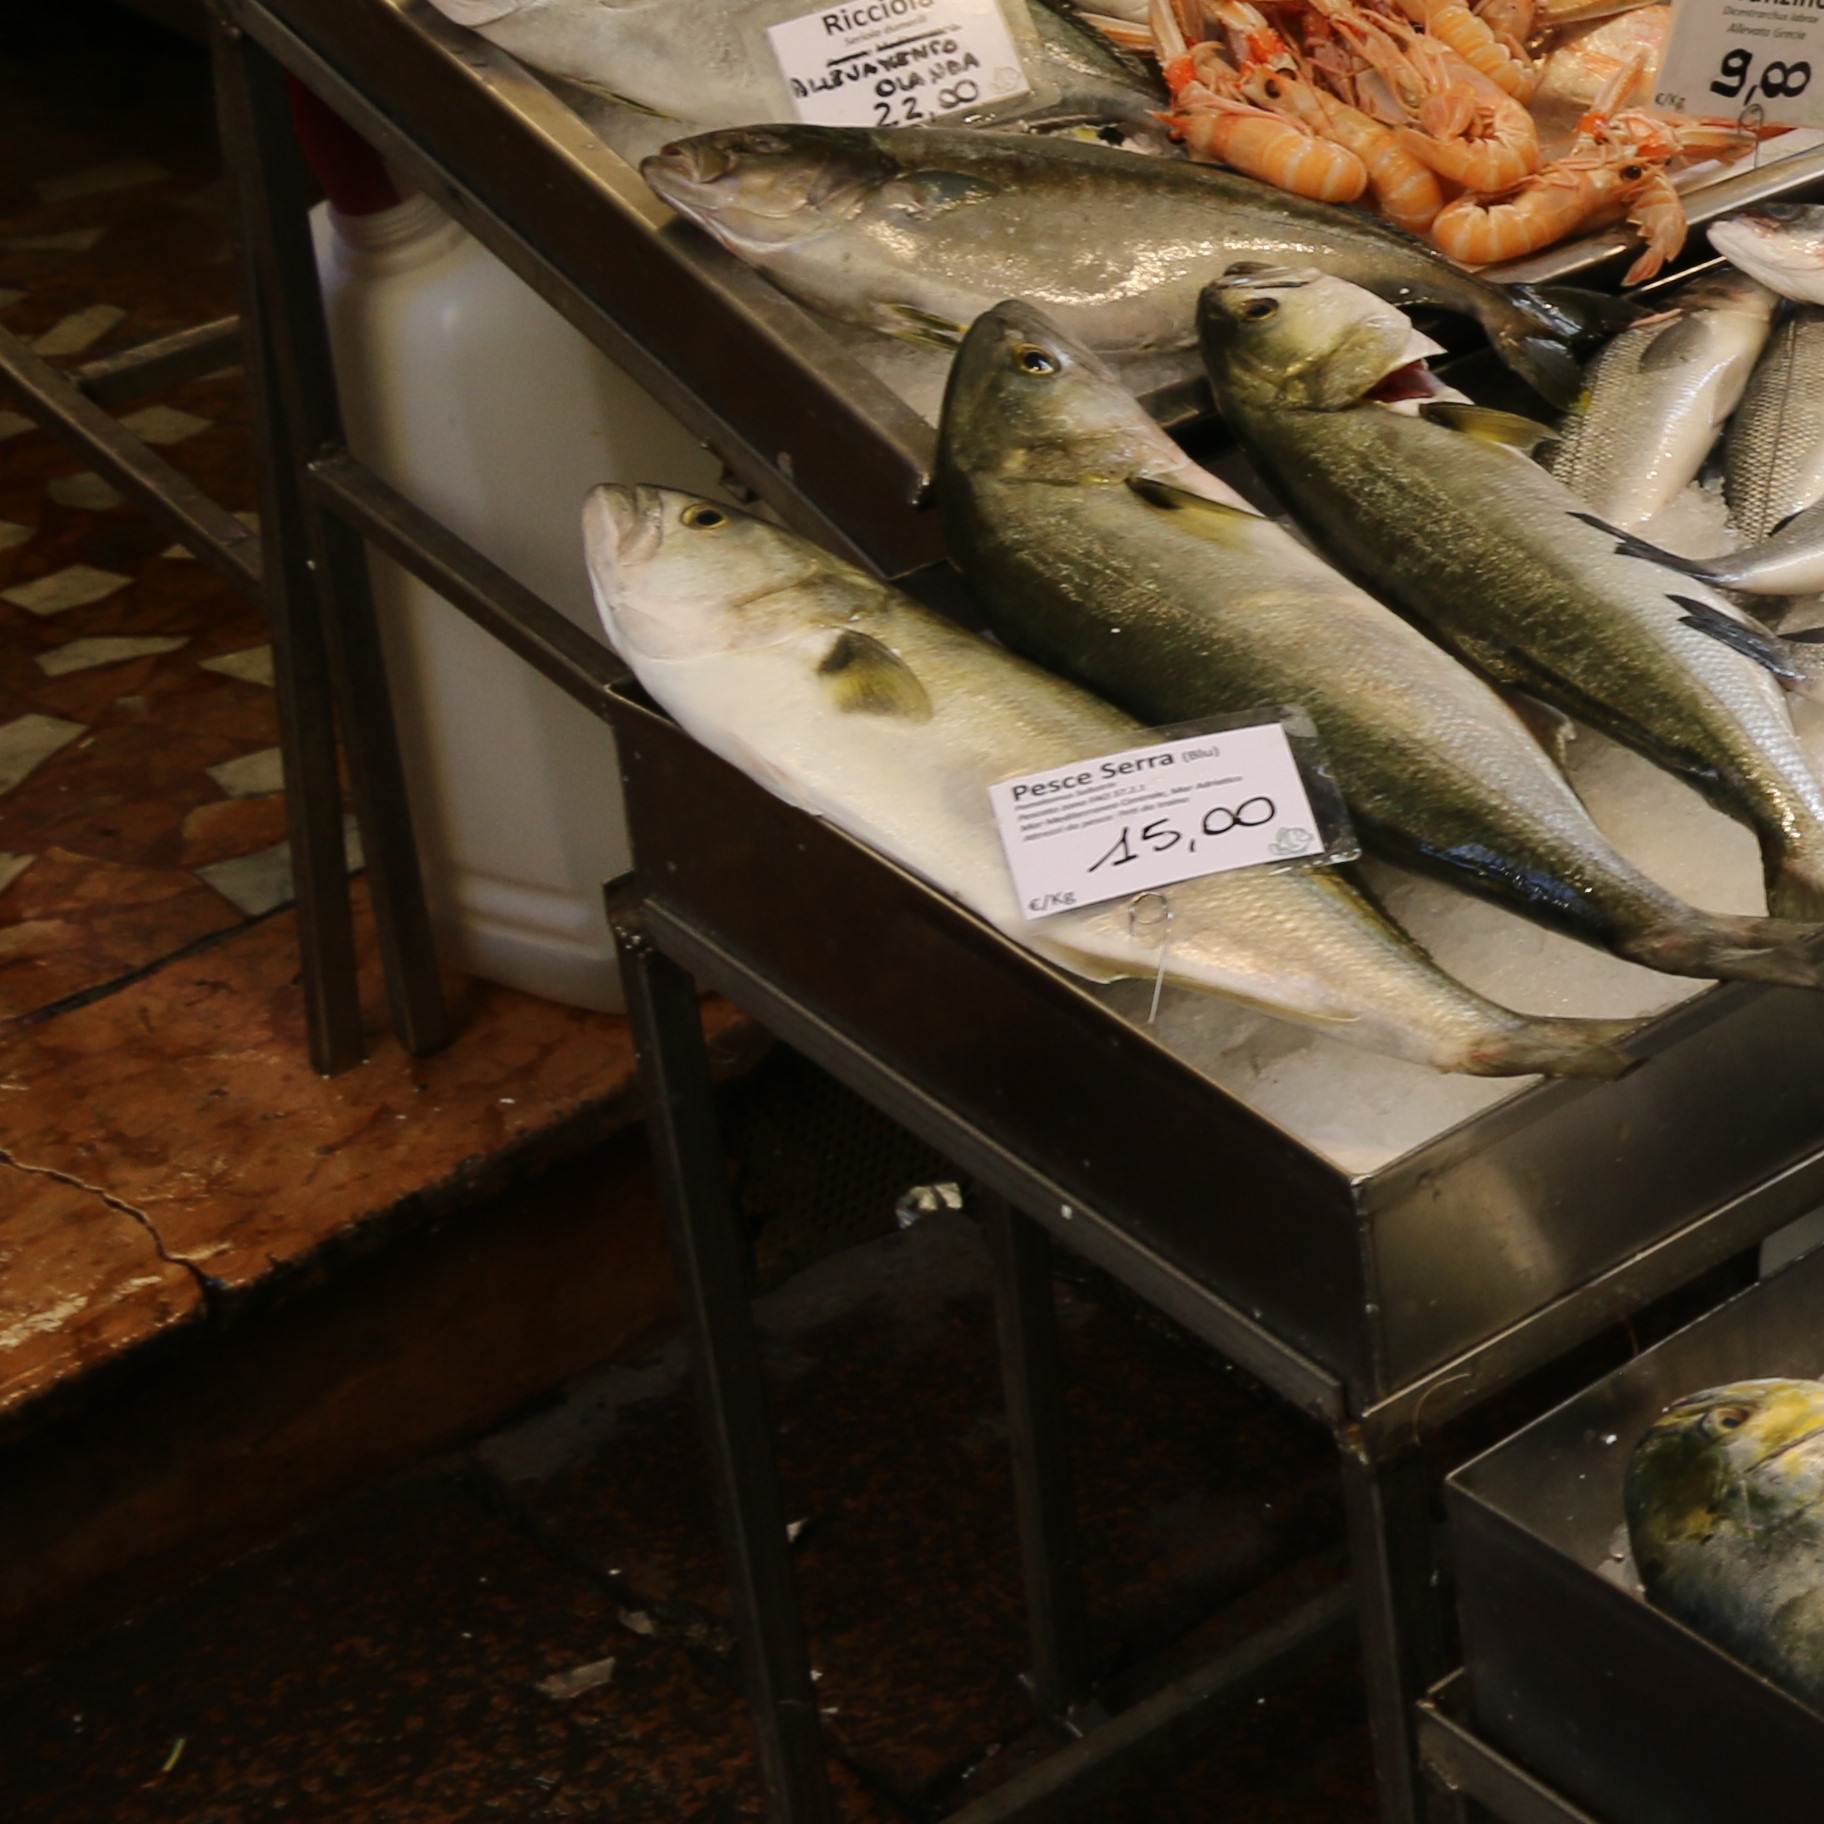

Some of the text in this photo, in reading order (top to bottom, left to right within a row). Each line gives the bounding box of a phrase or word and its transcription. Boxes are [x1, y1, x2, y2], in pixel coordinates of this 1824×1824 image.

[1710, 48, 1812, 105] 9,00
[1011, 746, 1220, 803] Pesce Serra (Blu)
[1088, 796, 1276, 873] 15,00
[1028, 889, 1077, 912] €/Kg
